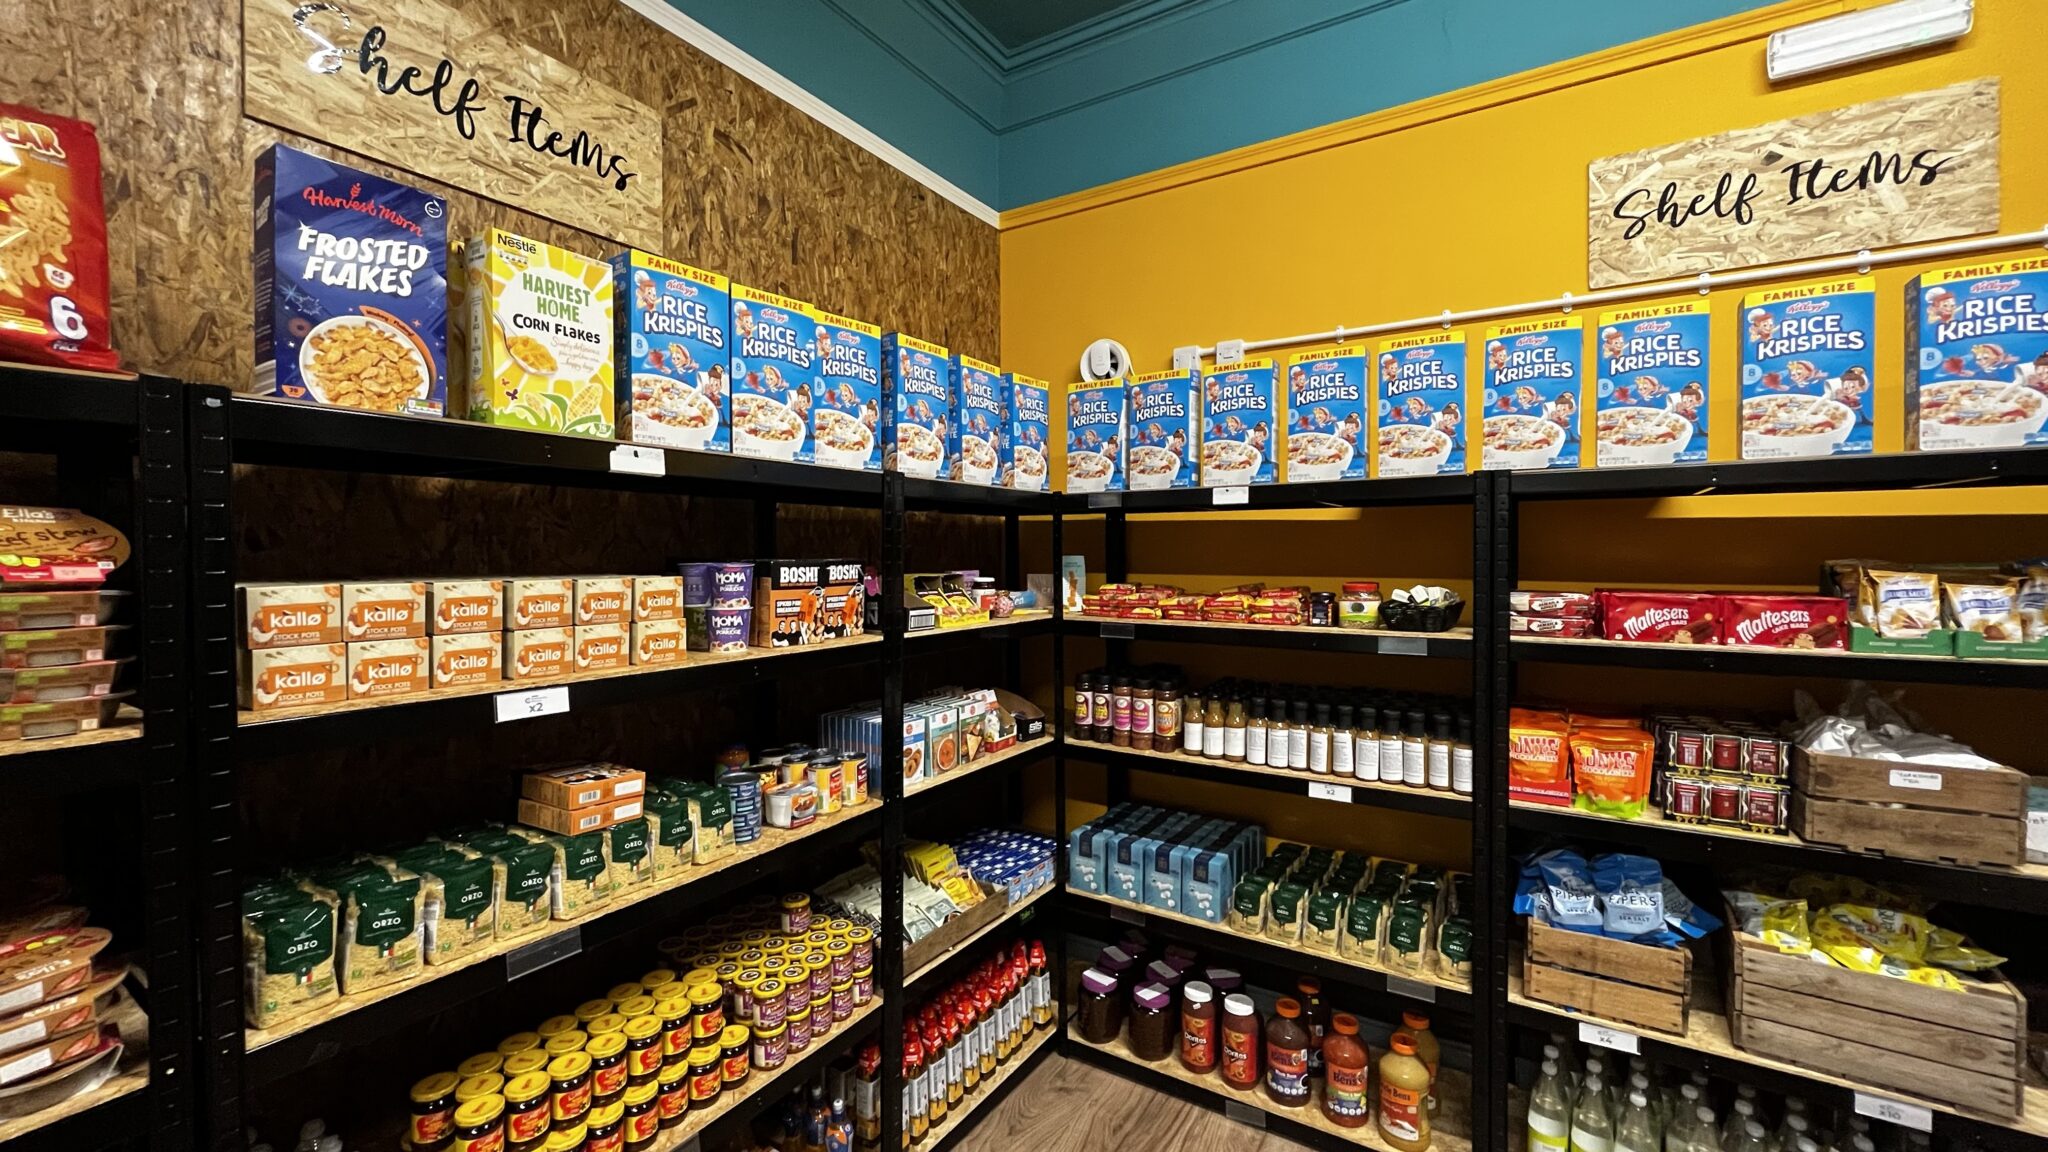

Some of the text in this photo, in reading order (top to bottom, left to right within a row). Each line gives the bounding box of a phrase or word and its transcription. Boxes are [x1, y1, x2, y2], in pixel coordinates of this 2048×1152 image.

[292, 2, 486, 141] Shelf
[1613, 173, 1764, 240] Shelf
[297, 226, 430, 271] FROSTED
[302, 255, 413, 297] FLAKES
[647, 257, 716, 285] FAMILY SIZE
[1943, 259, 2048, 281] FAMILY SIZE
[522, 272, 591, 307] HARVEST
[1763, 282, 1856, 302] FAMILY SIZE
[537, 296, 580, 323] HOME
[663, 295, 706, 324] RICE
[745, 289, 804, 312] FAMILY SIZE
[1965, 294, 2033, 319] RICE
[50, 295, 88, 340] 6
[512, 313, 550, 333] CORN
[1615, 304, 1694, 322] FAMILY SIZE
[644, 312, 724, 348] KRISPIES
[824, 314, 872, 334] FAMILY SIZE
[1500, 319, 1568, 335] FAMILY SIZE
[1782, 314, 1841, 338] RICE
[1937, 312, 2048, 344] KRISPIES
[758, 323, 796, 347] RICE
[1391, 334, 1452, 349] FAMILY SIZE
[1631, 334, 1681, 354] RICE
[742, 338, 810, 368] KRISPIES
[835, 345, 866, 365] RICE
[1299, 348, 1353, 362] FAMILY SIZE
[1757, 330, 1865, 361] KRISPIES
[1213, 360, 1262, 373] FAMILY SIZE
[1512, 347, 1556, 366] RICE
[1610, 349, 1701, 376] KRISPIES
[822, 360, 878, 385] KRISPIES
[914, 365, 936, 384] RICE
[1403, 361, 1442, 378] RICE
[1494, 362, 1574, 386] KRISPIES
[904, 378, 946, 401] KRISPIES
[974, 383, 992, 399] RICE
[1310, 373, 1345, 389] RICE
[1387, 374, 1458, 397] KRISPIES
[1147, 392, 1174, 407] RICE
[1223, 384, 1254, 399] RICE
[1296, 385, 1359, 407] KRISPIES
[966, 394, 999, 415] KRISPIES
[1026, 398, 1044, 412] RICE
[1083, 401, 1108, 414] RICE
[1136, 404, 1185, 422] KRISPIES
[1210, 396, 1267, 415] KRISPIES
[1019, 409, 1048, 425] KRISPIES
[1073, 412, 1118, 428] KRISPIES
[2, 508, 55, 520] Ella's
[780, 566, 819, 583] BOSH!
[828, 564, 860, 580] BOSH!
[1623, 607, 1689, 640] Maltesers
[1736, 610, 1811, 644] Maltesers
[521, 877, 543, 887] ORZO
[461, 891, 483, 903] ORZO
[372, 916, 401, 929] ORZO
[287, 939, 318, 955] ORZO
[1184, 1032, 1207, 1044] Doritos
